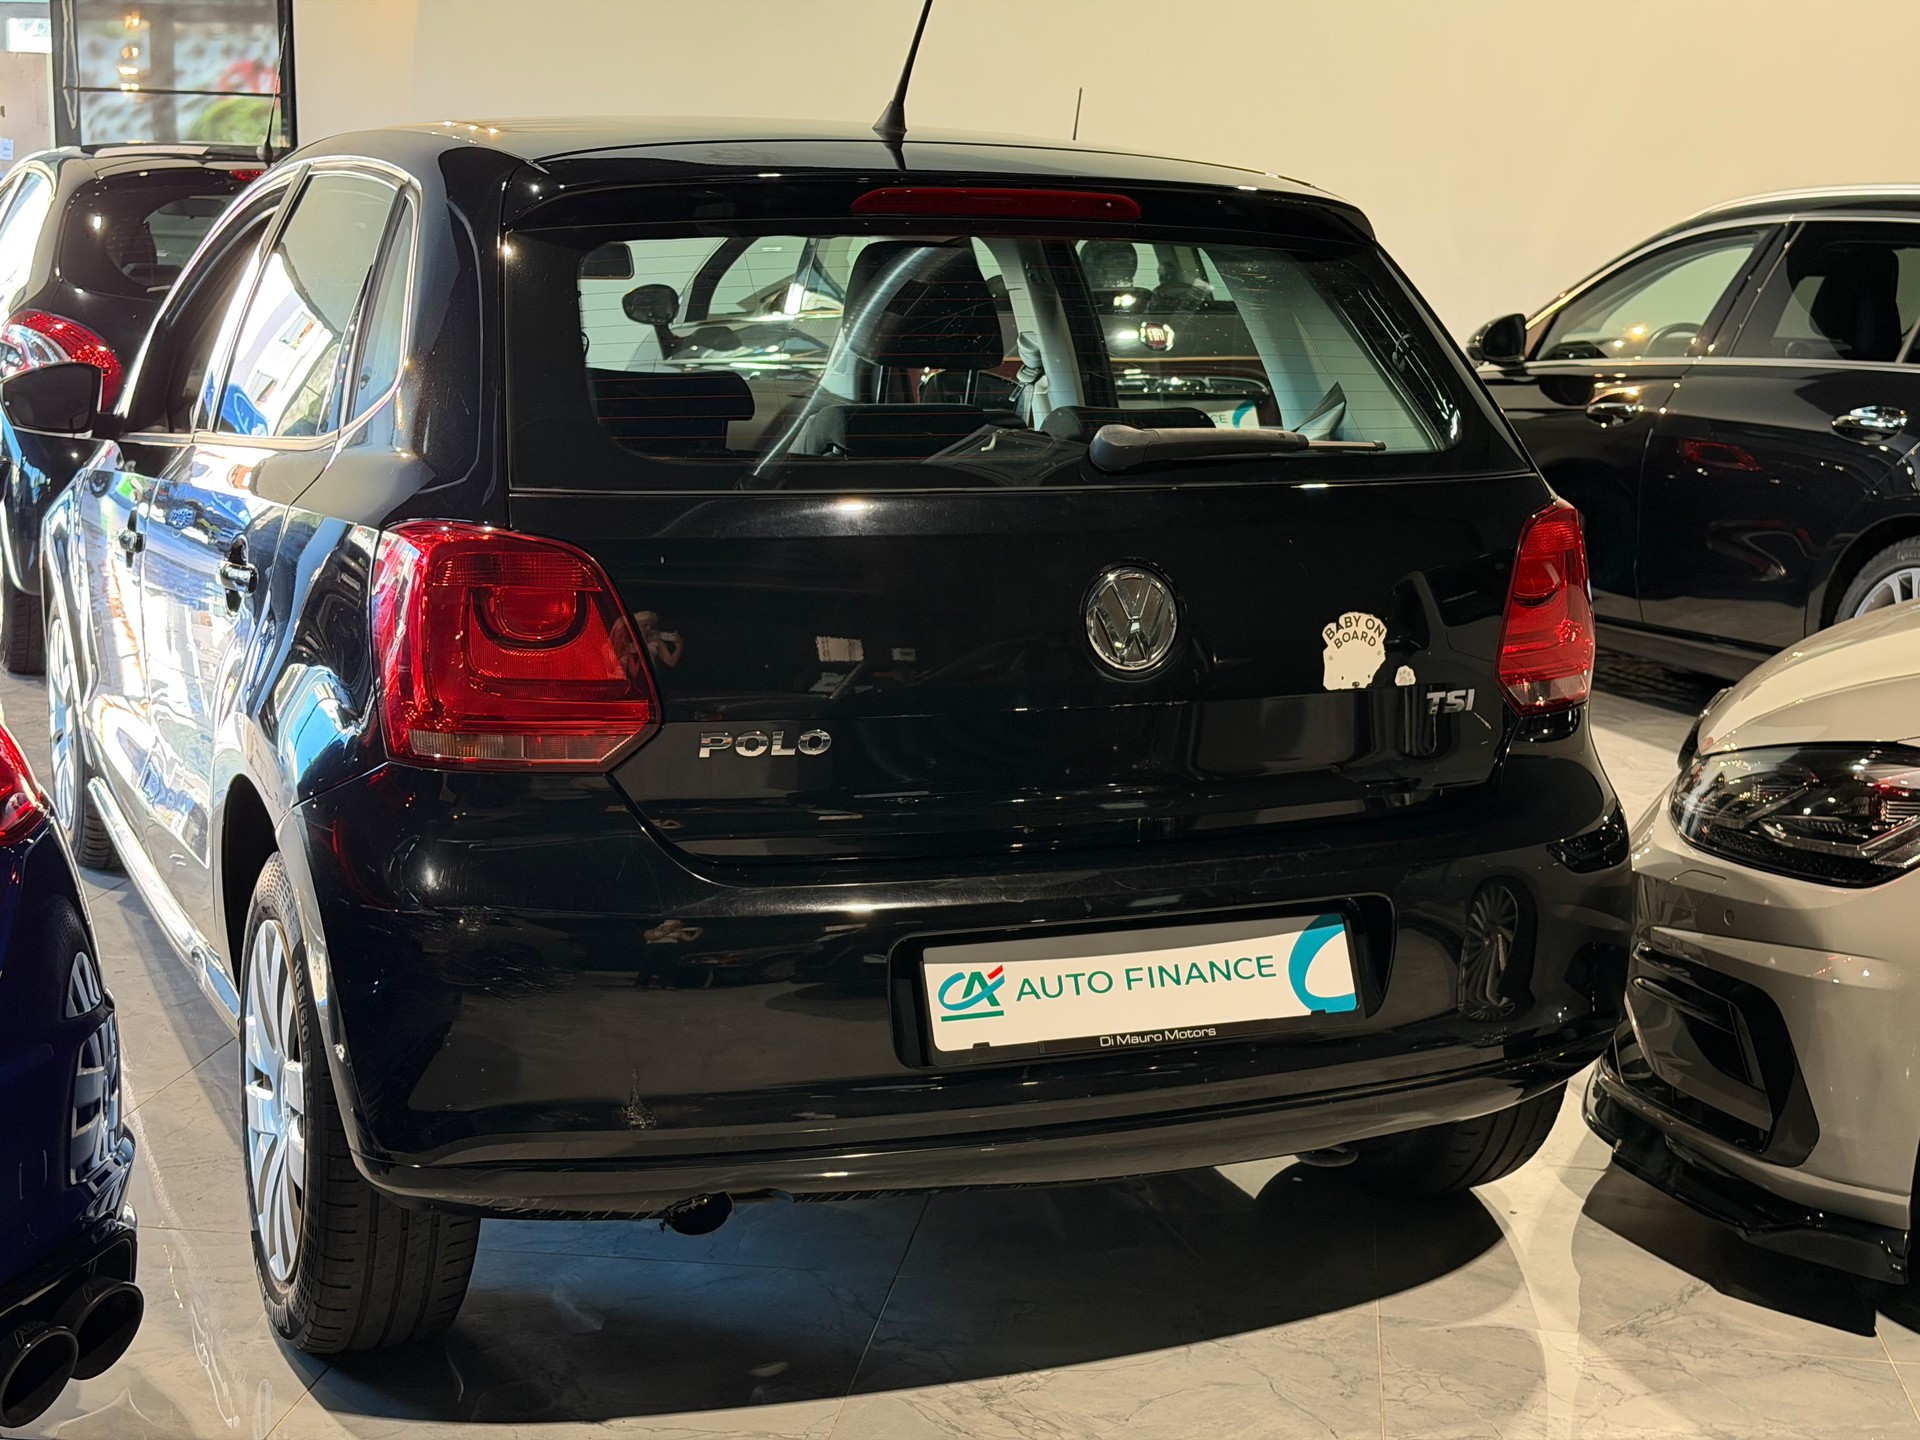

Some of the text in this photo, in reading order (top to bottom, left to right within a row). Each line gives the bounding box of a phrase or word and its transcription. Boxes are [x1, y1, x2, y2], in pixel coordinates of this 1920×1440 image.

[1324, 615, 1385, 641] BABY ON
[1333, 630, 1377, 649] BOARD
[1427, 689, 1475, 714] TSI
[699, 729, 832, 758] POLO
[1016, 971, 1113, 1001] AUTO
[1125, 955, 1277, 990] FINANCE
[294, 959, 310, 1042] 185/60
[1100, 1028, 1216, 1047] Di Mauro Motors
